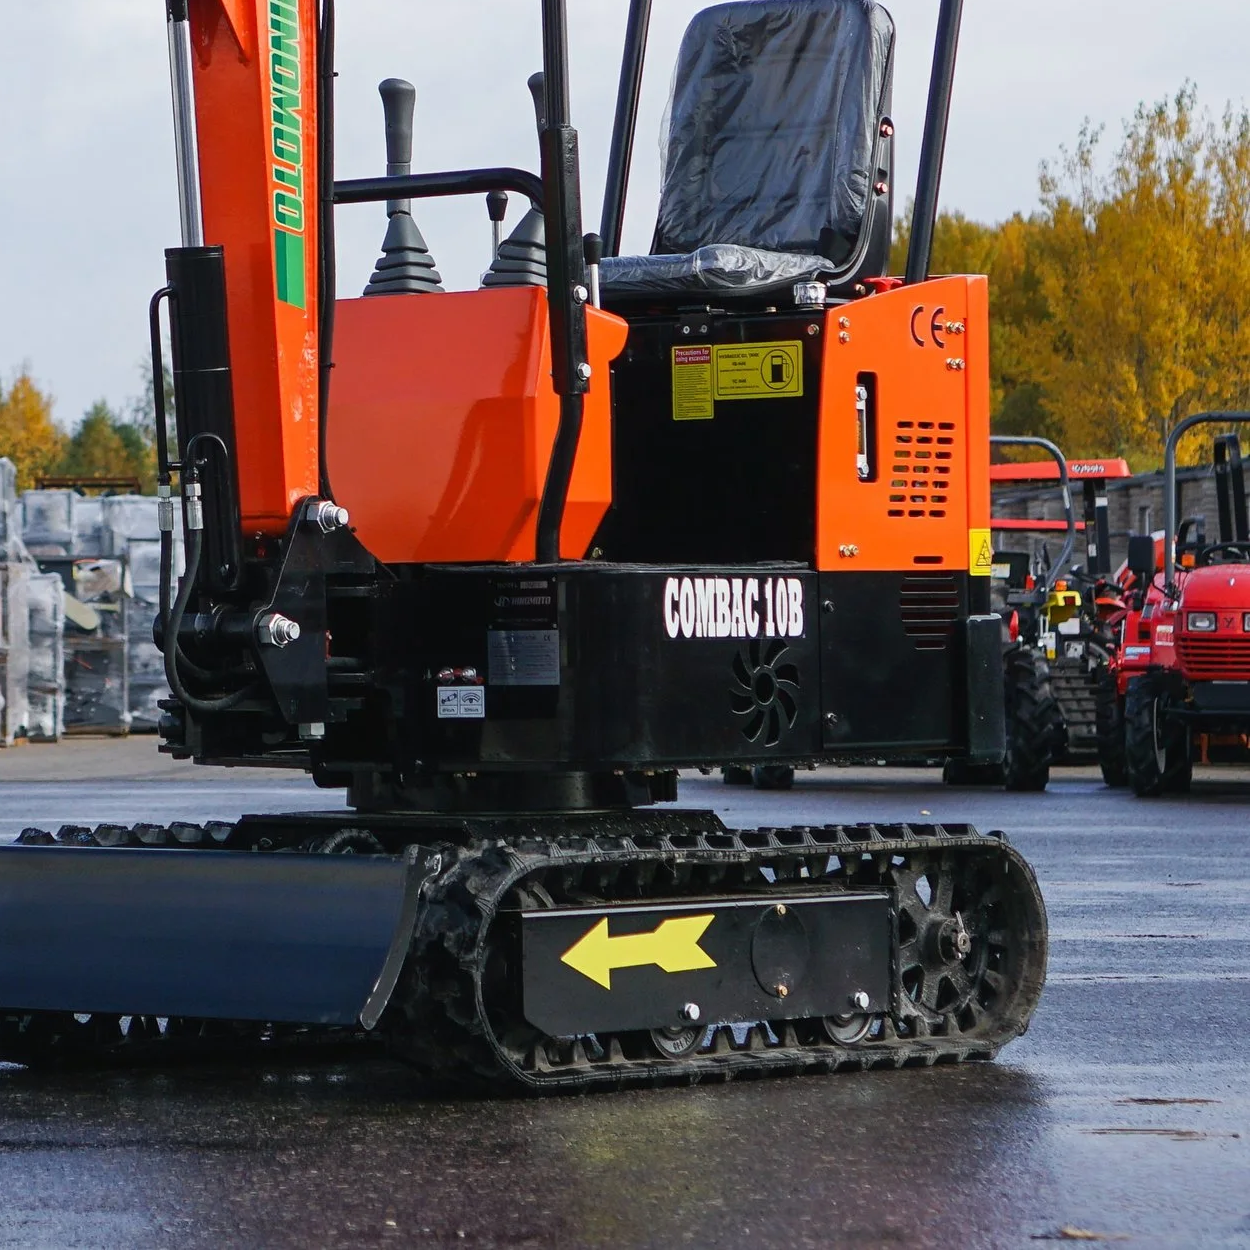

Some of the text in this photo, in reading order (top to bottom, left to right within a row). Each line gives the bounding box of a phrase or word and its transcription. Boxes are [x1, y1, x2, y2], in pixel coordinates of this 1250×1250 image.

[910, 306, 945, 349] CE
[1071, 463, 1104, 473] Kubota
[664, 577, 804, 638] COMBAC 10B
